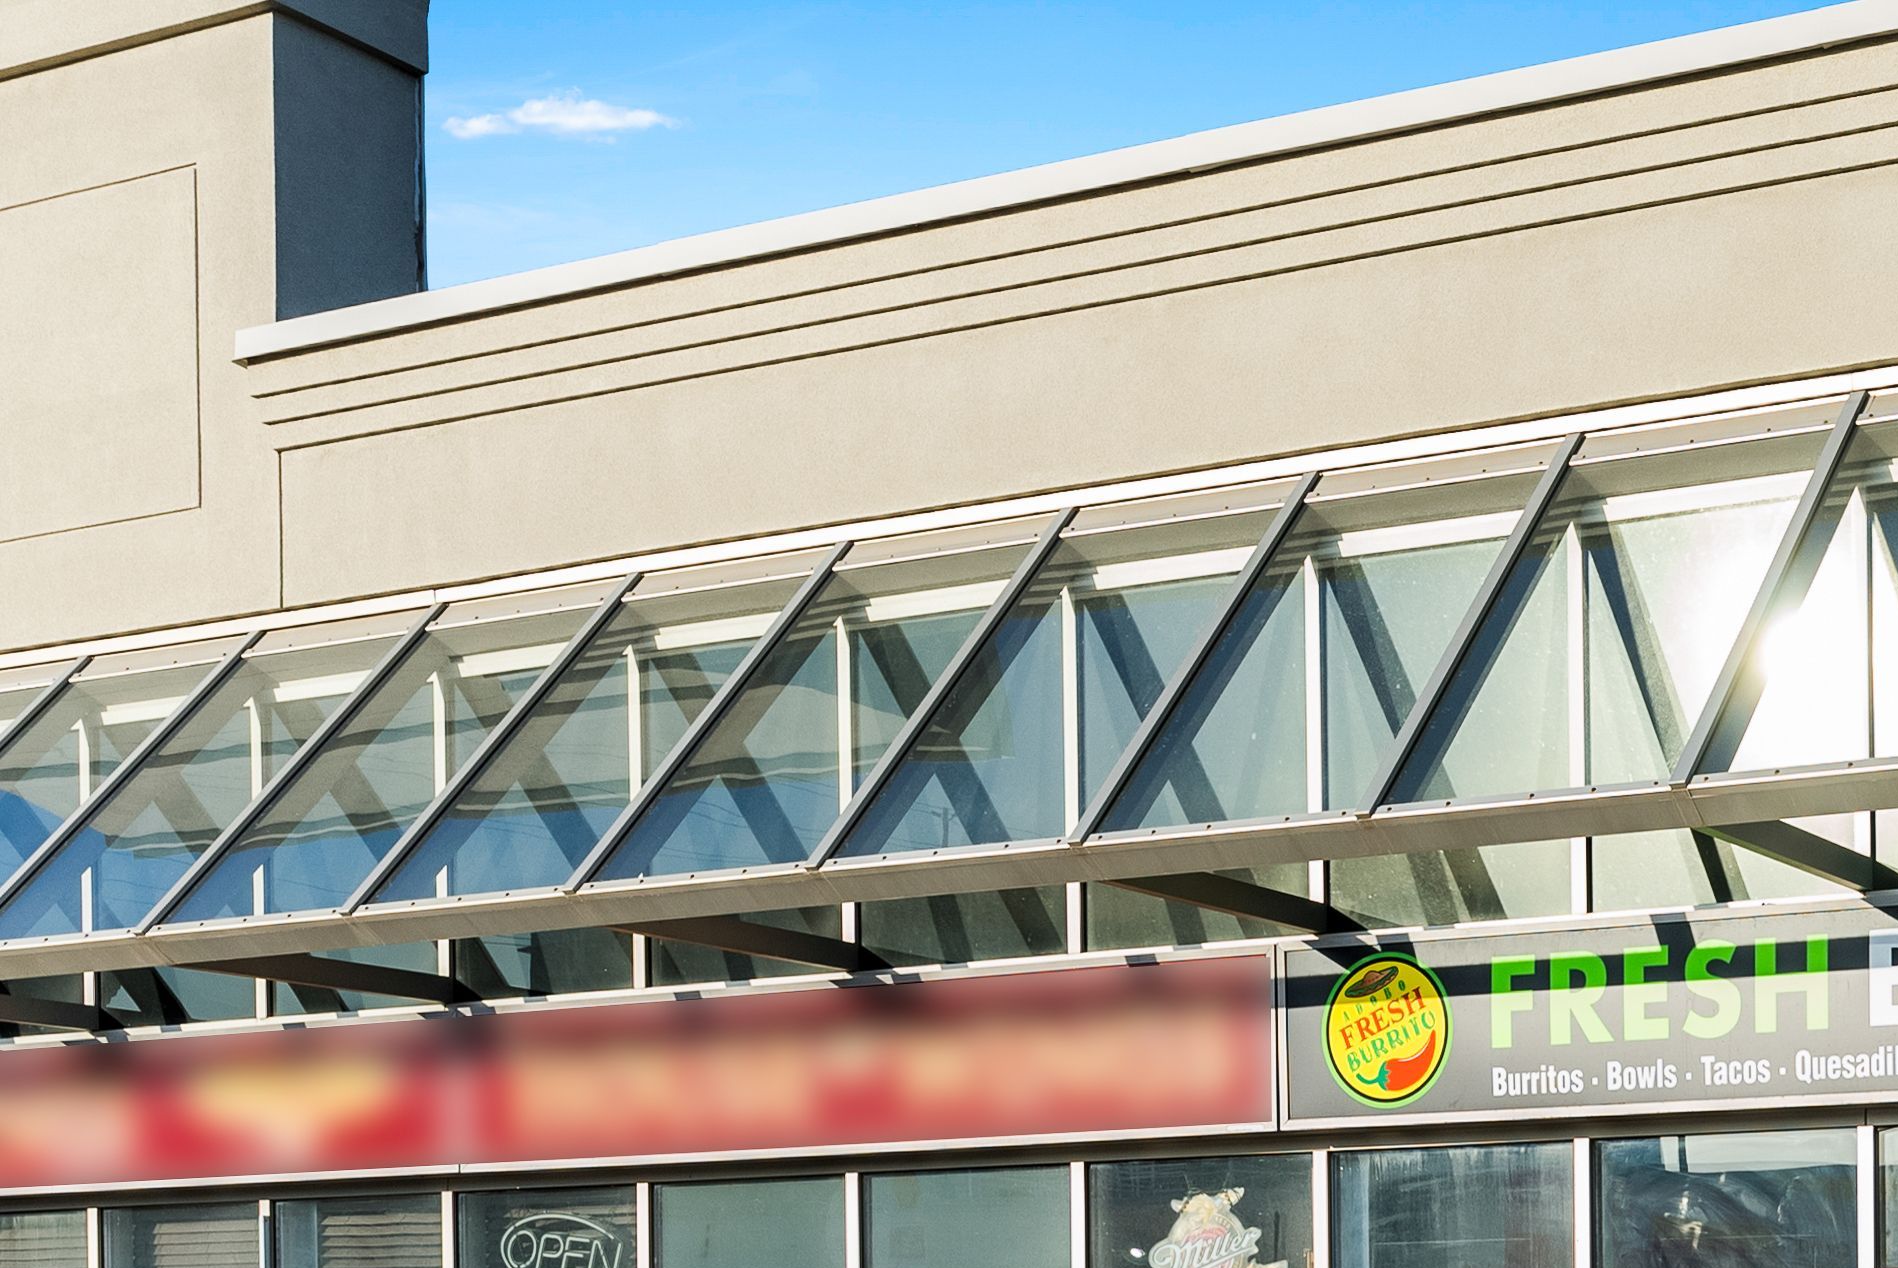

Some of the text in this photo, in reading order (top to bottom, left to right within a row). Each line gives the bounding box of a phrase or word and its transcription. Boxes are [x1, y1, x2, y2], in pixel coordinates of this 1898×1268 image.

[1340, 987, 1427, 1050] FRESH
[1491, 934, 1829, 1048] FRESH
[1347, 1011, 1436, 1072] BURRITO
[1492, 1065, 1584, 1097] Burritos
[1607, 1058, 1678, 1091] Bowls
[1700, 1055, 1771, 1086] Tacos
